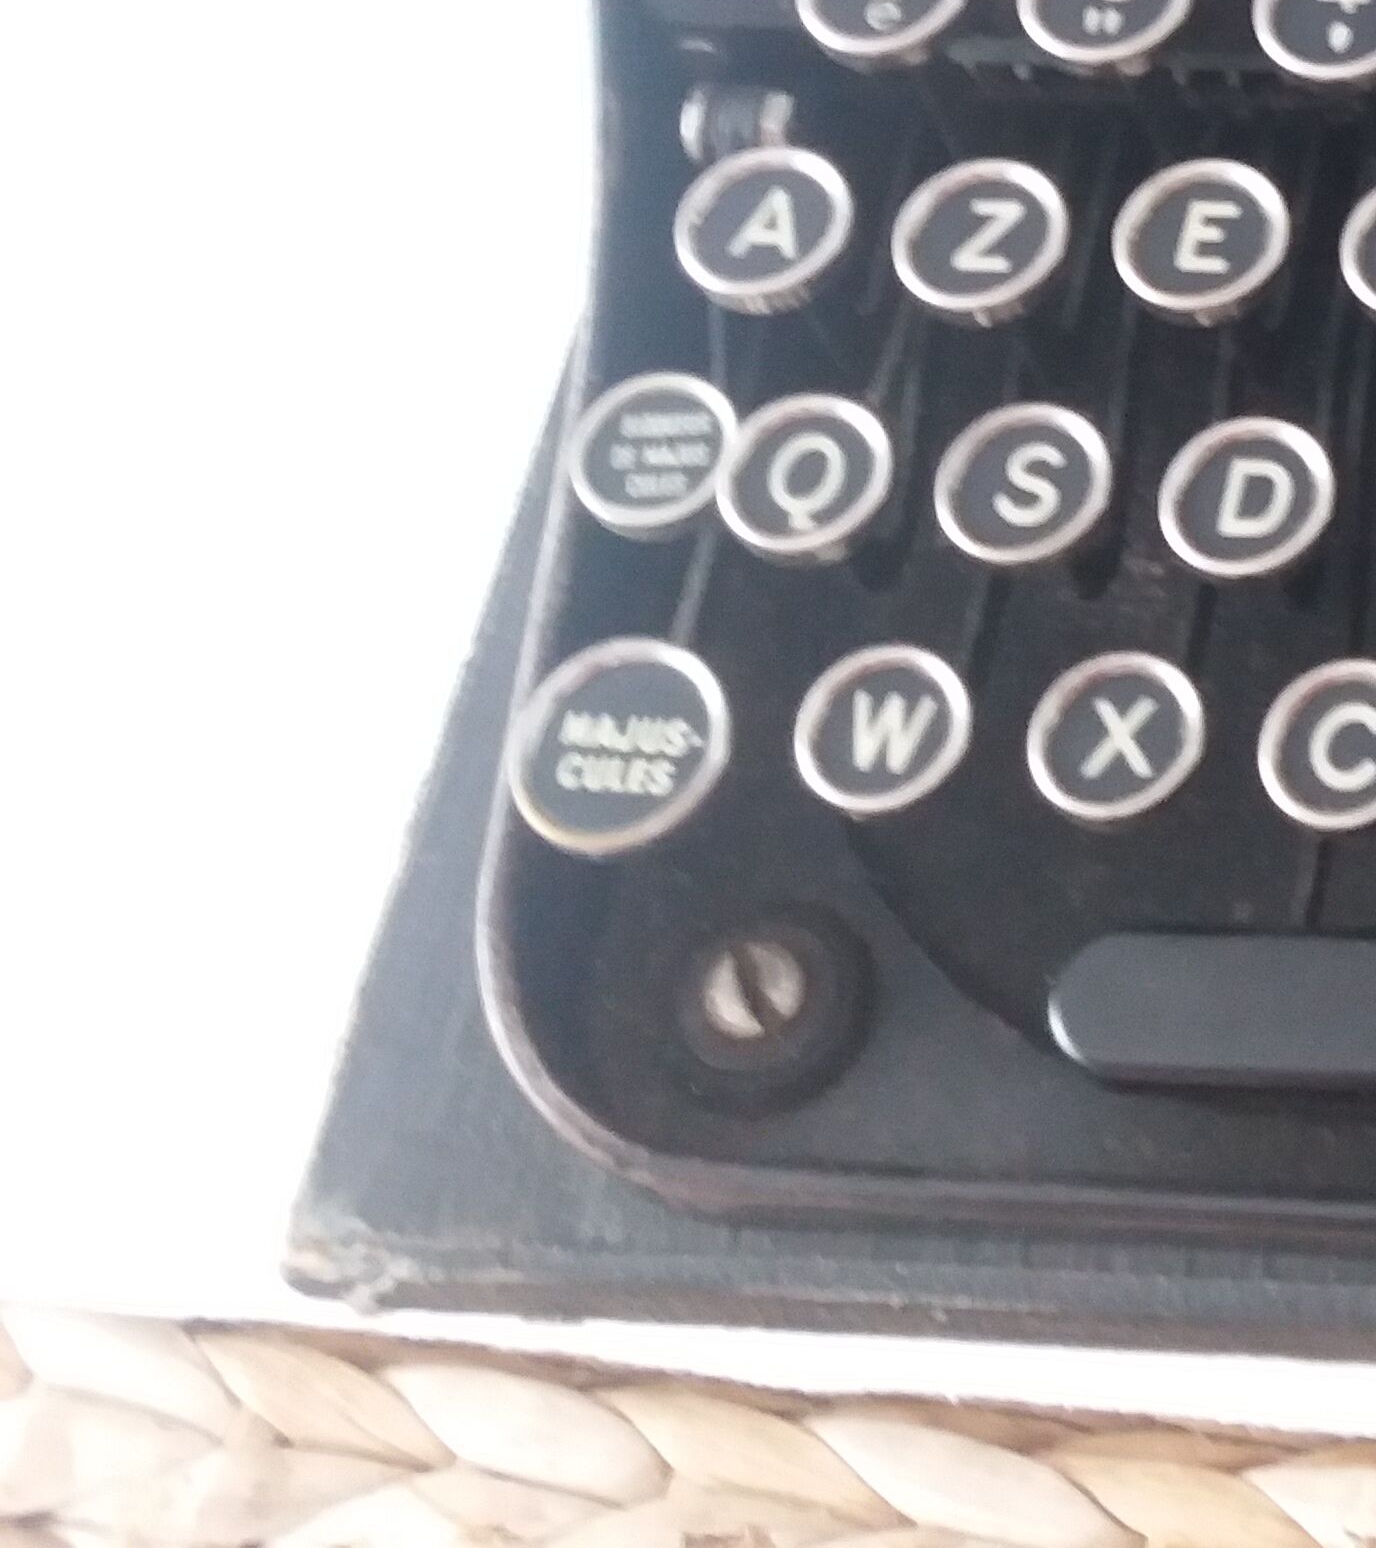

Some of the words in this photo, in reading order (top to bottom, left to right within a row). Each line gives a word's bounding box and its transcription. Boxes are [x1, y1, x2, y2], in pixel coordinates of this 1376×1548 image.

[729, 188, 796, 258] A
[952, 200, 1024, 272] Z
[1175, 201, 1241, 273] E
[767, 435, 849, 529] Q
[994, 443, 1064, 526] S
[1218, 459, 1293, 537] D
[853, 692, 937, 774] W
[1082, 699, 1154, 777] X
[556, 753, 675, 795] CULES
